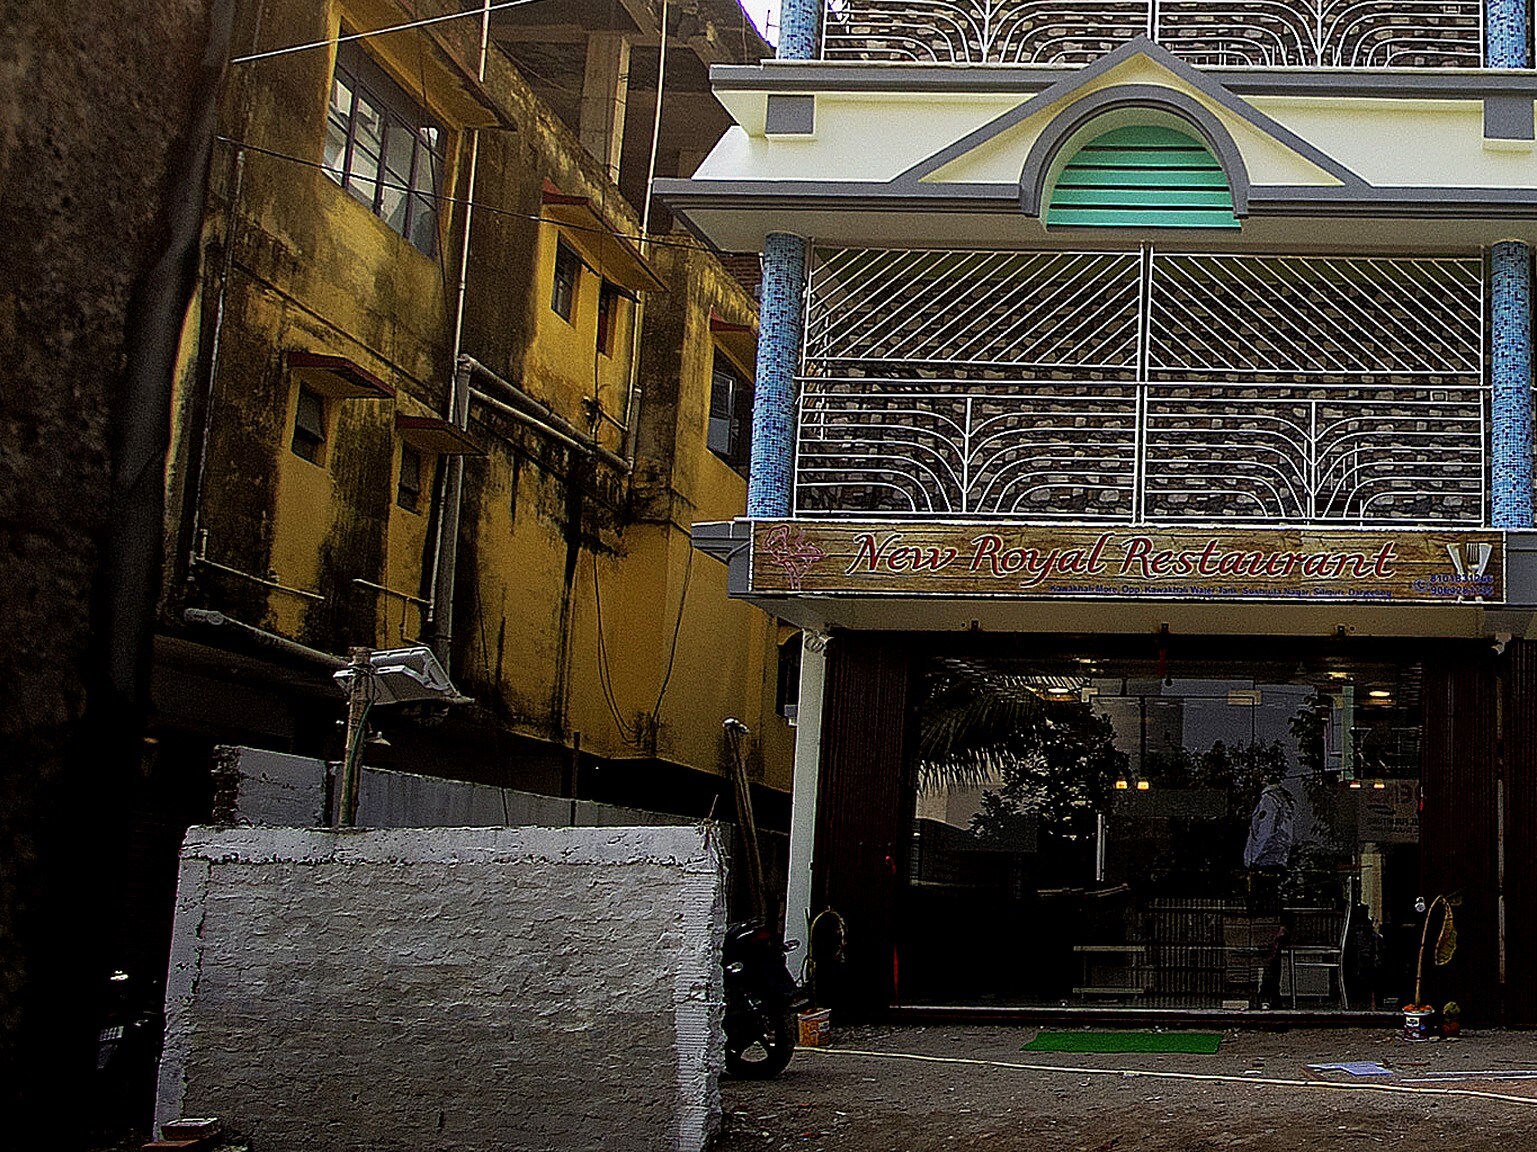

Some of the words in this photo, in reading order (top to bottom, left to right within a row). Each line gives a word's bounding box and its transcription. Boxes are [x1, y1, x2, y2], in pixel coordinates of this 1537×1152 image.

[844, 533, 958, 576] New
[969, 532, 1117, 588] Royal
[1119, 536, 1399, 579] Restaurant
